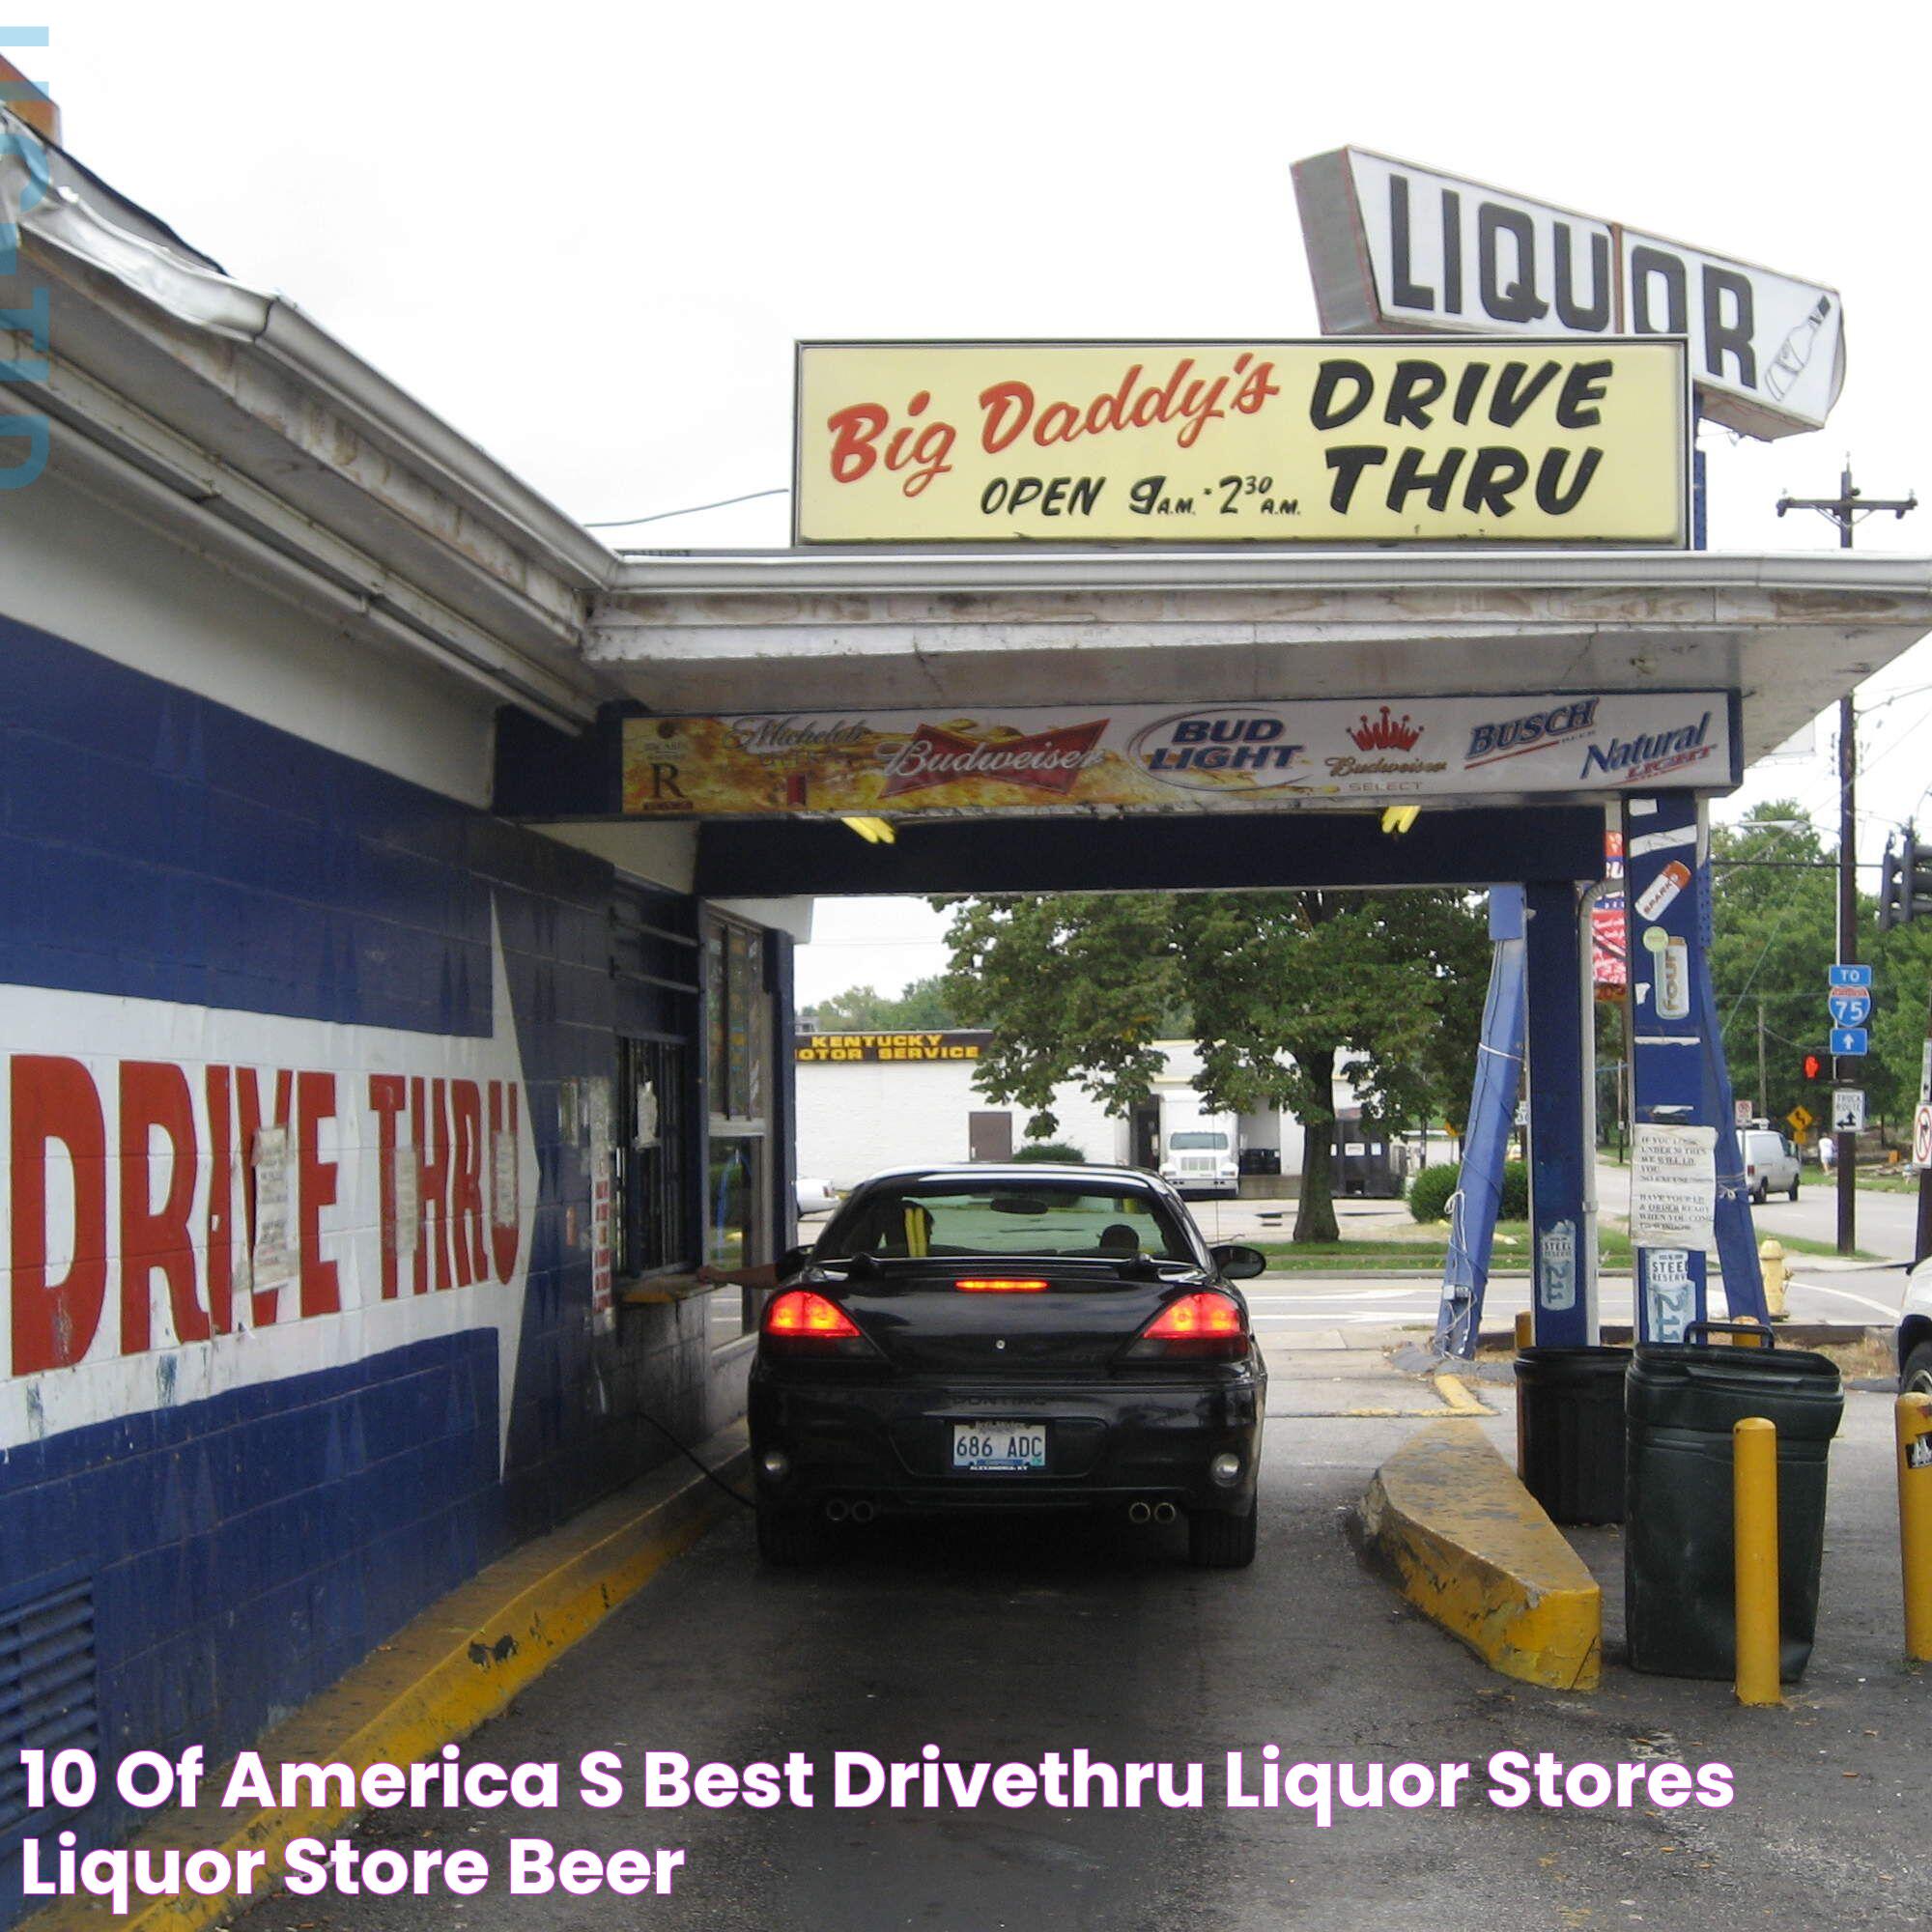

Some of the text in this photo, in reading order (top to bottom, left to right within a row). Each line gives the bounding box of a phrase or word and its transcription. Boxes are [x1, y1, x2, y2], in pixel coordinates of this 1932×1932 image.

[1389, 172, 1758, 390] LIQUOR
[1309, 358, 1614, 431] DRIVE
[827, 352, 1281, 497] Big Daddy's
[980, 475, 1107, 516] OPEN
[1324, 444, 1605, 518] THRU
[1172, 719, 1284, 744] BUD
[1464, 696, 1601, 760] BUSCH
[874, 736, 1106, 779] Budweiser
[1149, 744, 1305, 772] LIGHT
[1578, 710, 1713, 781] Natural
[1324, 755, 1448, 777] Budweiser
[1349, 781, 1423, 792] SELECT
[1839, 969, 1860, 982] TO
[1835, 1001, 1864, 1021] 75
[794, 1046, 980, 1061] OTOR SERVICE
[810, 1034, 943, 1048] KENTUCKY
[10, 1053, 341, 1377] DRIVE
[368, 1073, 520, 1301] THRU
[956, 1435, 1042, 1458] 686 ADC
